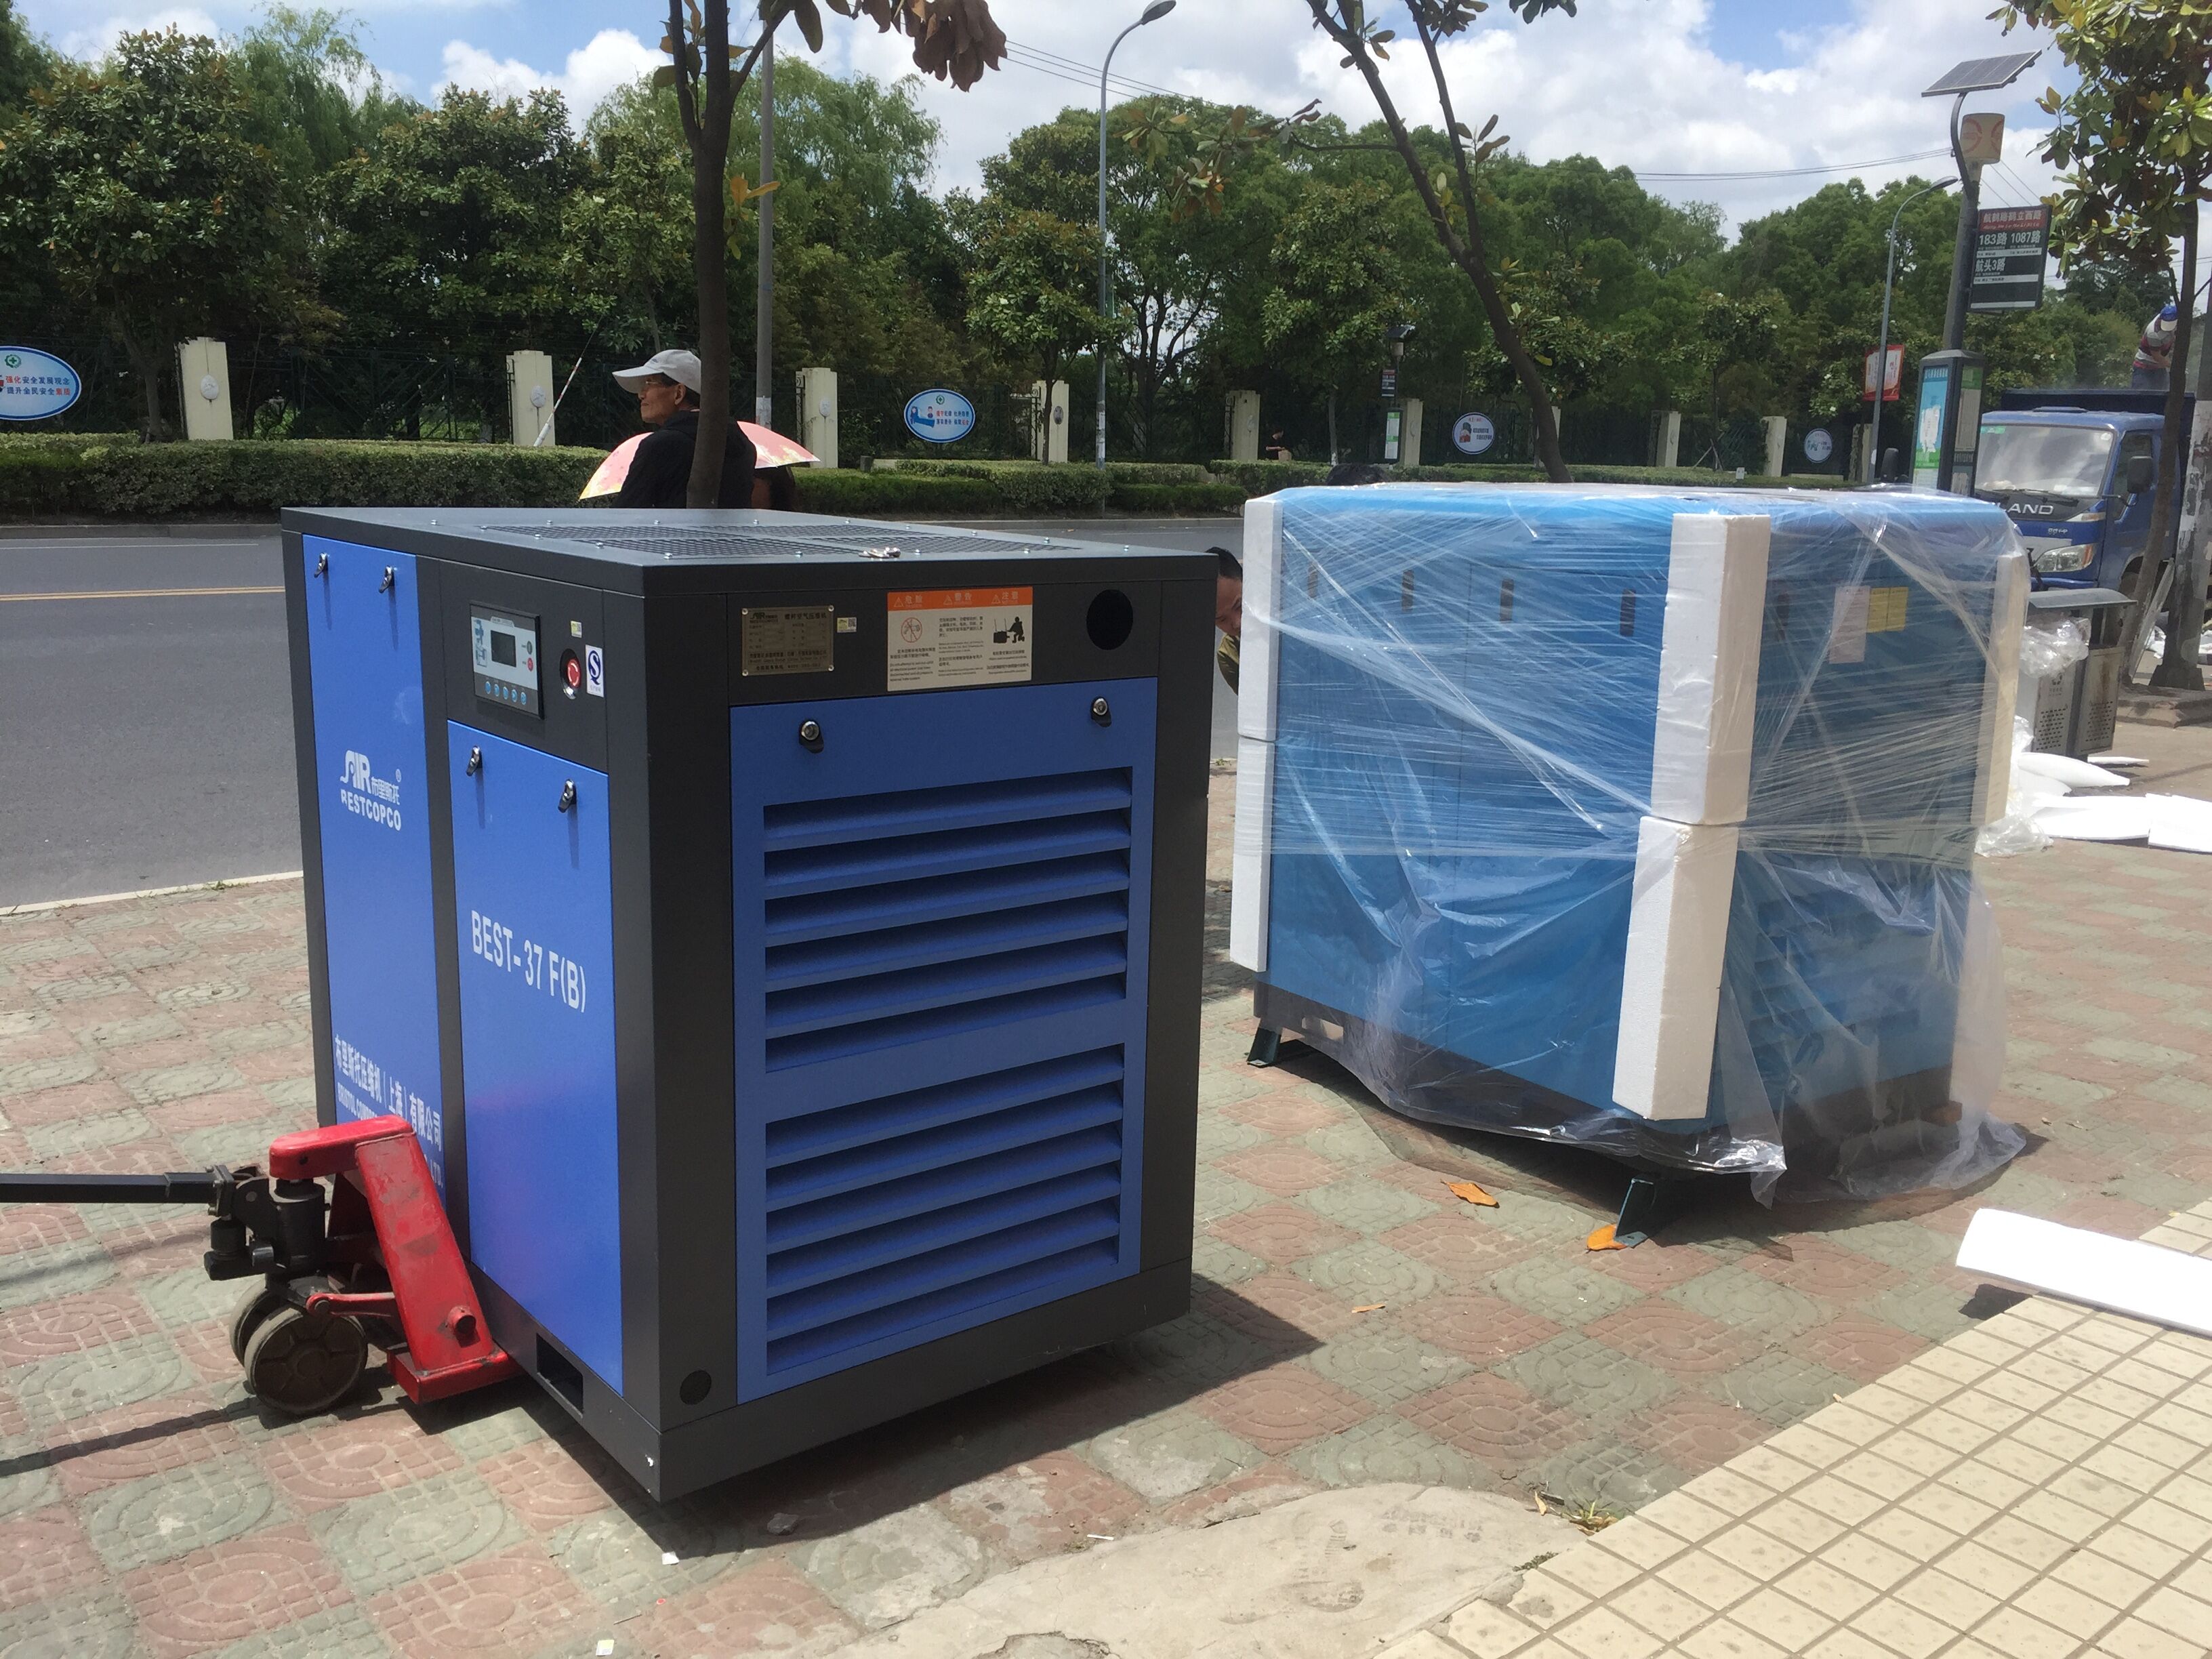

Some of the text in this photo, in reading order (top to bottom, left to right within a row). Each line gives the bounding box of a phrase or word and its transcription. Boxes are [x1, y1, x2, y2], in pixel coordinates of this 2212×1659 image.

[1979, 230, 2041, 245] 183路 1087路
[1975, 258, 2006, 272] 航头3路
[5, 375, 70, 385] 强化安全发展观念
[340, 789, 401, 832] RESTCOPCO
